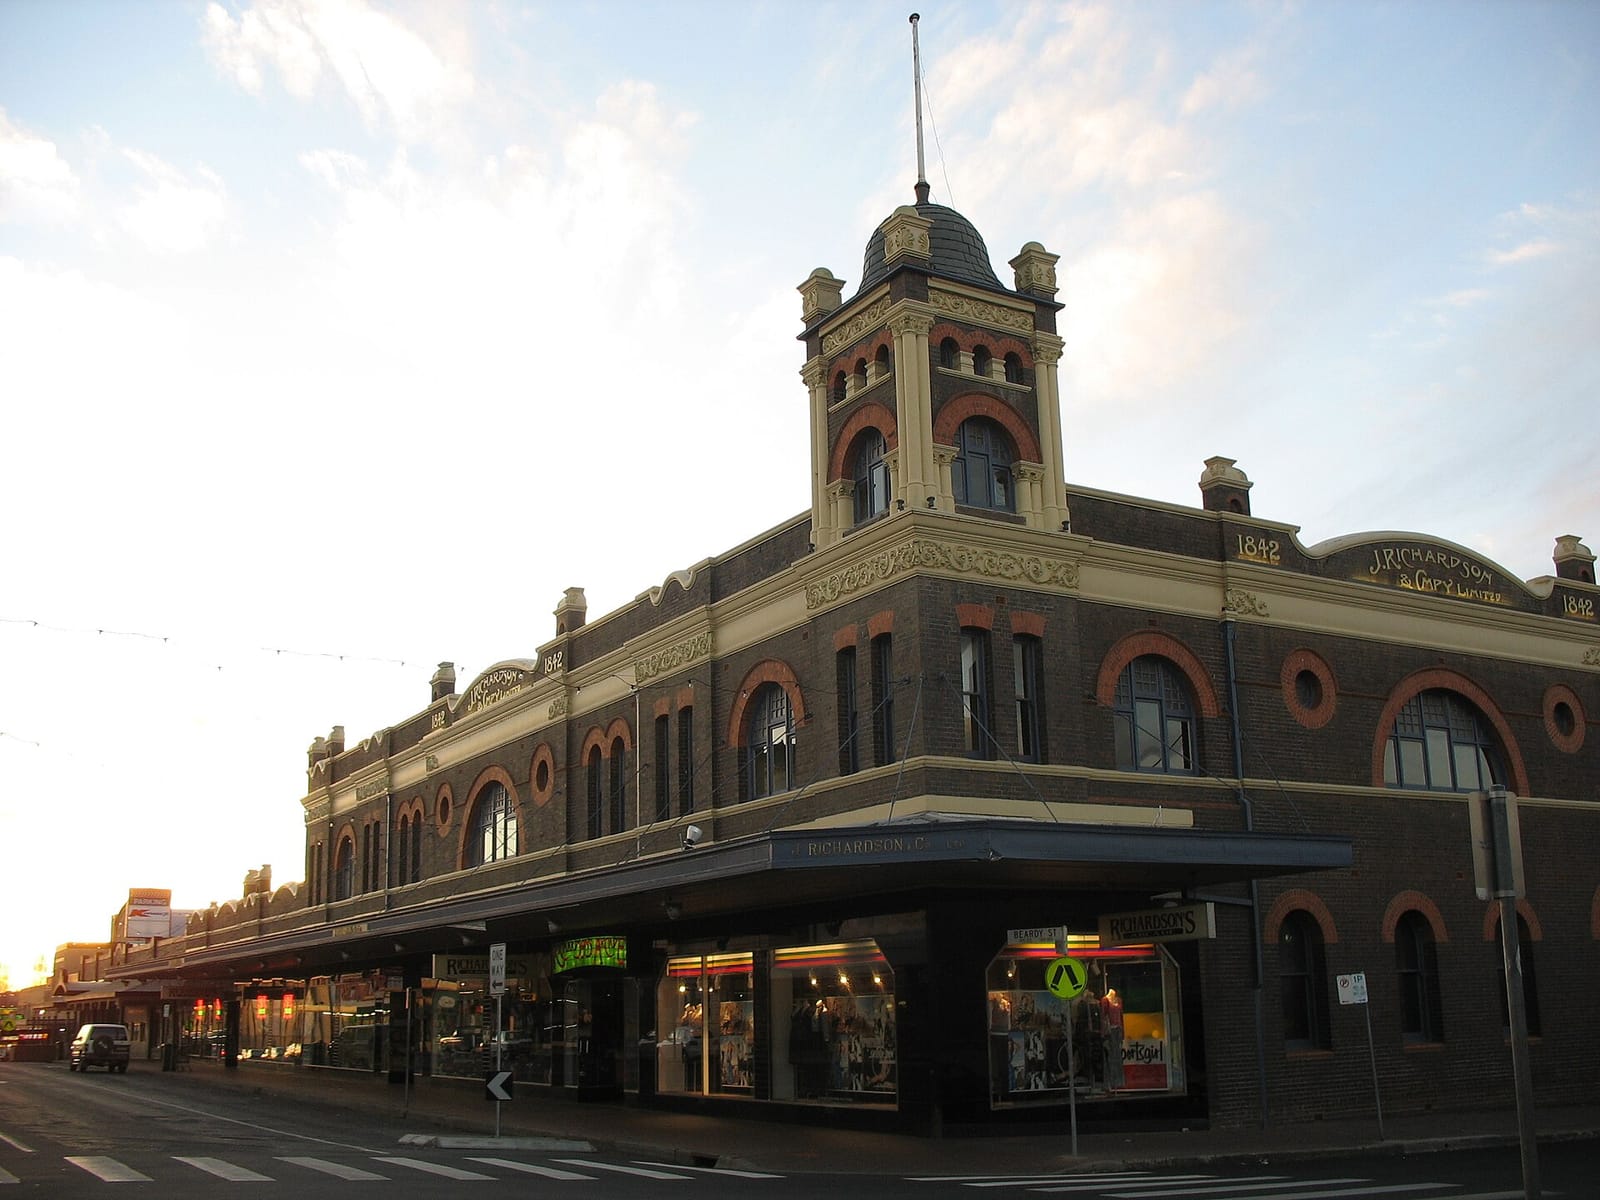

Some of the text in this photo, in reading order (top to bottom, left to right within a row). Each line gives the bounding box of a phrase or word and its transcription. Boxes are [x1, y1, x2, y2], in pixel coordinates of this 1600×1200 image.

[1237, 534, 1281, 562] 1842
[1400, 573, 1414, 590] &
[1563, 594, 1594, 617] 1842
[544, 651, 563, 674] 1842
[431, 710, 446, 729] 1842
[808, 837, 905, 857] RICHARDSON
[1013, 928, 1057, 939] BEARDY ST
[1110, 911, 1196, 941] RICHARDSON'S
[492, 949, 504, 961] ONE
[492, 964, 505, 977] WAY
[1120, 1040, 1164, 1064] portsgirl
